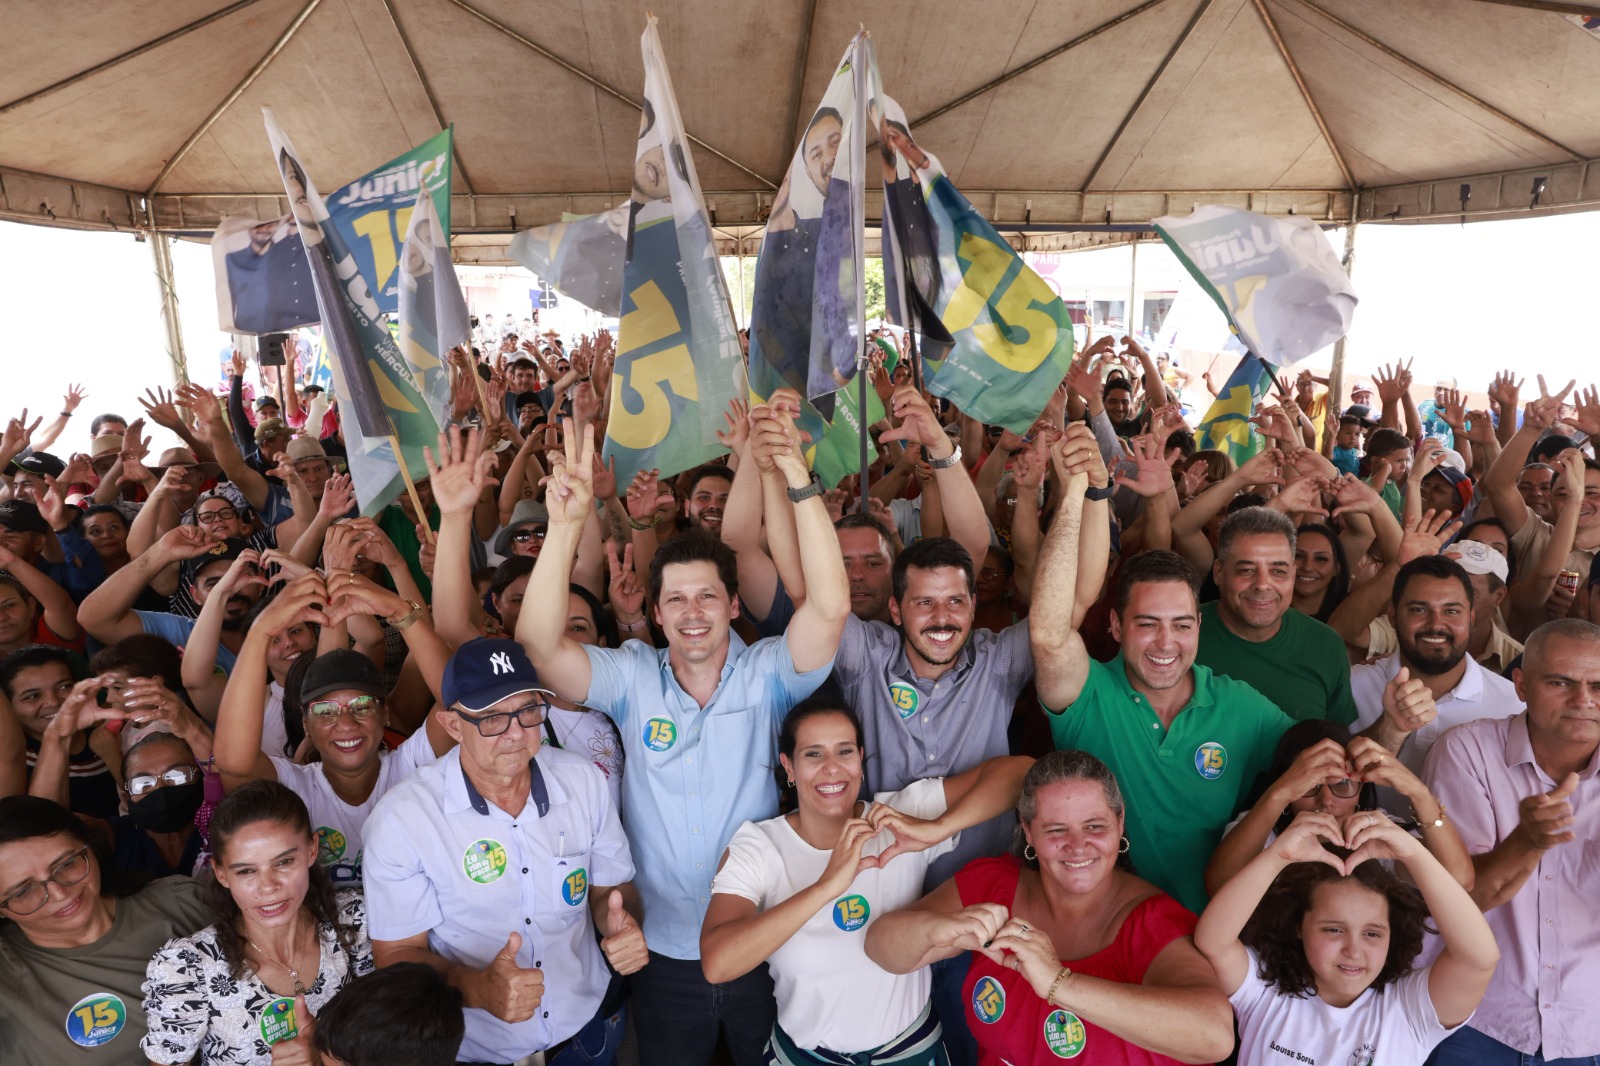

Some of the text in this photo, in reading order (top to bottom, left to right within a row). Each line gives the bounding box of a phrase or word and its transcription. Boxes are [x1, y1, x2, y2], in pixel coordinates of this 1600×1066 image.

[1033, 253, 1060, 265] PARE
[942, 232, 1058, 373] 15
[607, 279, 699, 449] 15
[490, 651, 515, 675] NY
[891, 687, 913, 709] 15
[649, 721, 673, 743] 15
[1201, 748, 1223, 769] 15
[327, 831, 345, 850] 15
[466, 854, 478, 865] Eu
[468, 861, 482, 872] vim
[486, 846, 506, 870] 15
[566, 871, 585, 899] 15
[837, 898, 865, 924] 15
[976, 981, 1001, 1015] 15
[75, 1000, 118, 1038] 15
[263, 1014, 276, 1027] Eu
[265, 1020, 288, 1035] vim de
[284, 1009, 297, 1031] 1
[1047, 1022, 1056, 1032] Eu
[1063, 1021, 1083, 1045] 15
